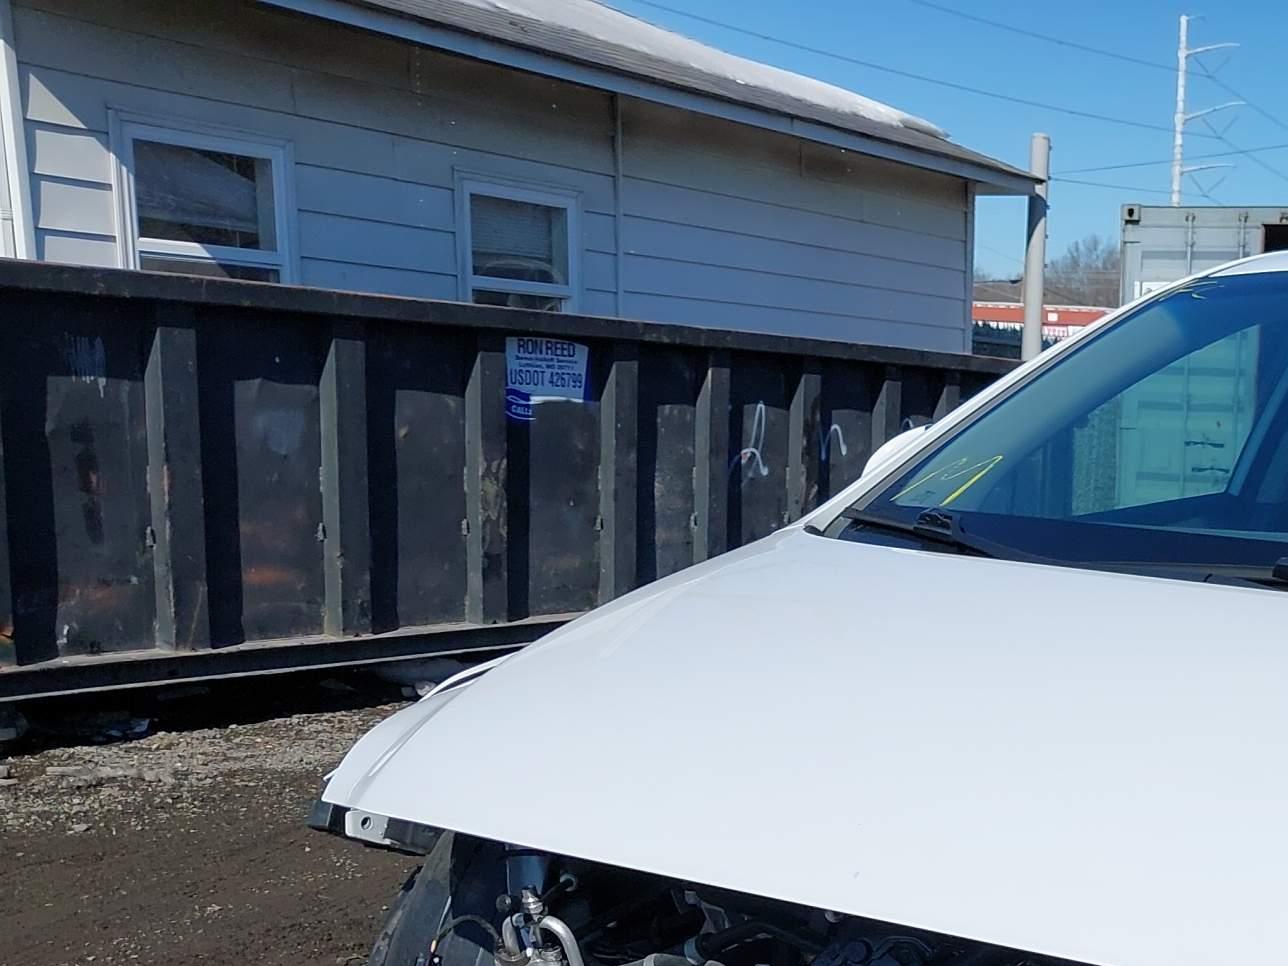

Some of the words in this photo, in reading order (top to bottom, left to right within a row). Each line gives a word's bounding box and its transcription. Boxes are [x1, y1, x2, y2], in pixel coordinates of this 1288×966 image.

[517, 338, 543, 355] RON
[545, 340, 576, 358] REED
[509, 368, 546, 387] USDOT
